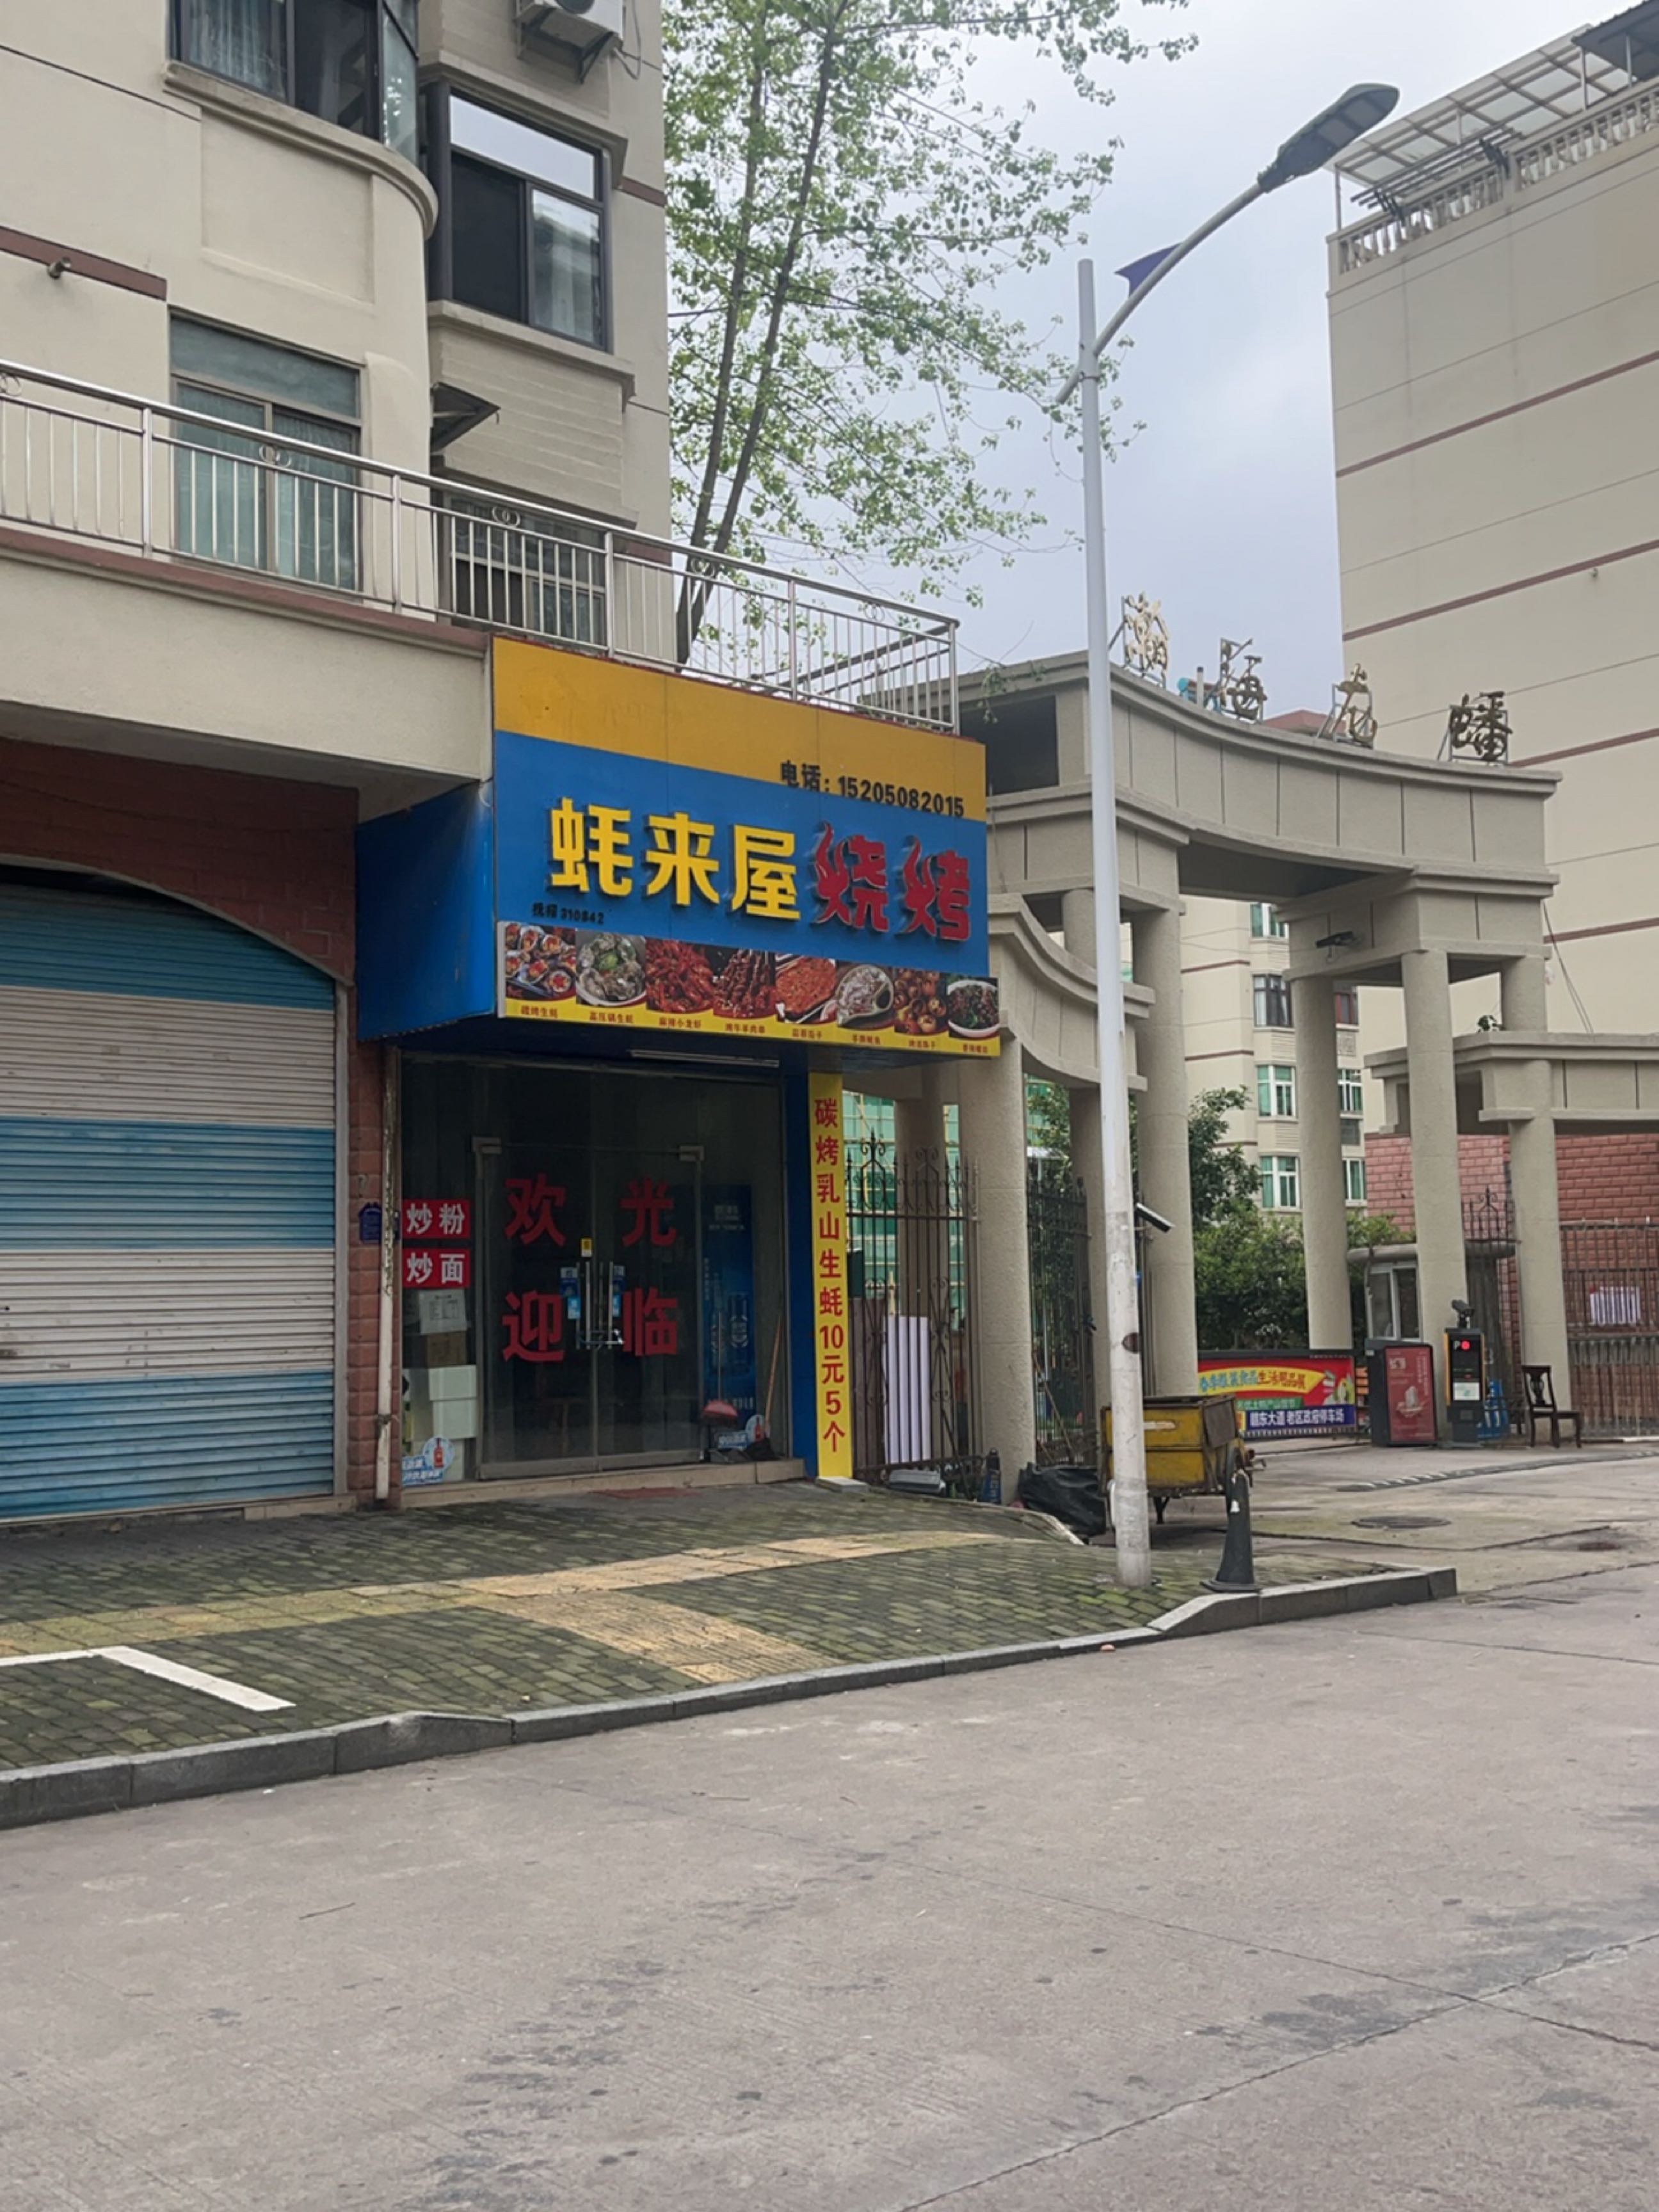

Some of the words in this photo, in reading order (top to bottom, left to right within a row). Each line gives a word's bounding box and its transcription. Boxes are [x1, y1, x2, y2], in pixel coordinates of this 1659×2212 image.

[406, 1203, 465, 1235] 炒粉
[406, 1252, 465, 1284] 炒面
[814, 1097, 846, 1453] 碳烤乳山生蚝10元5个
